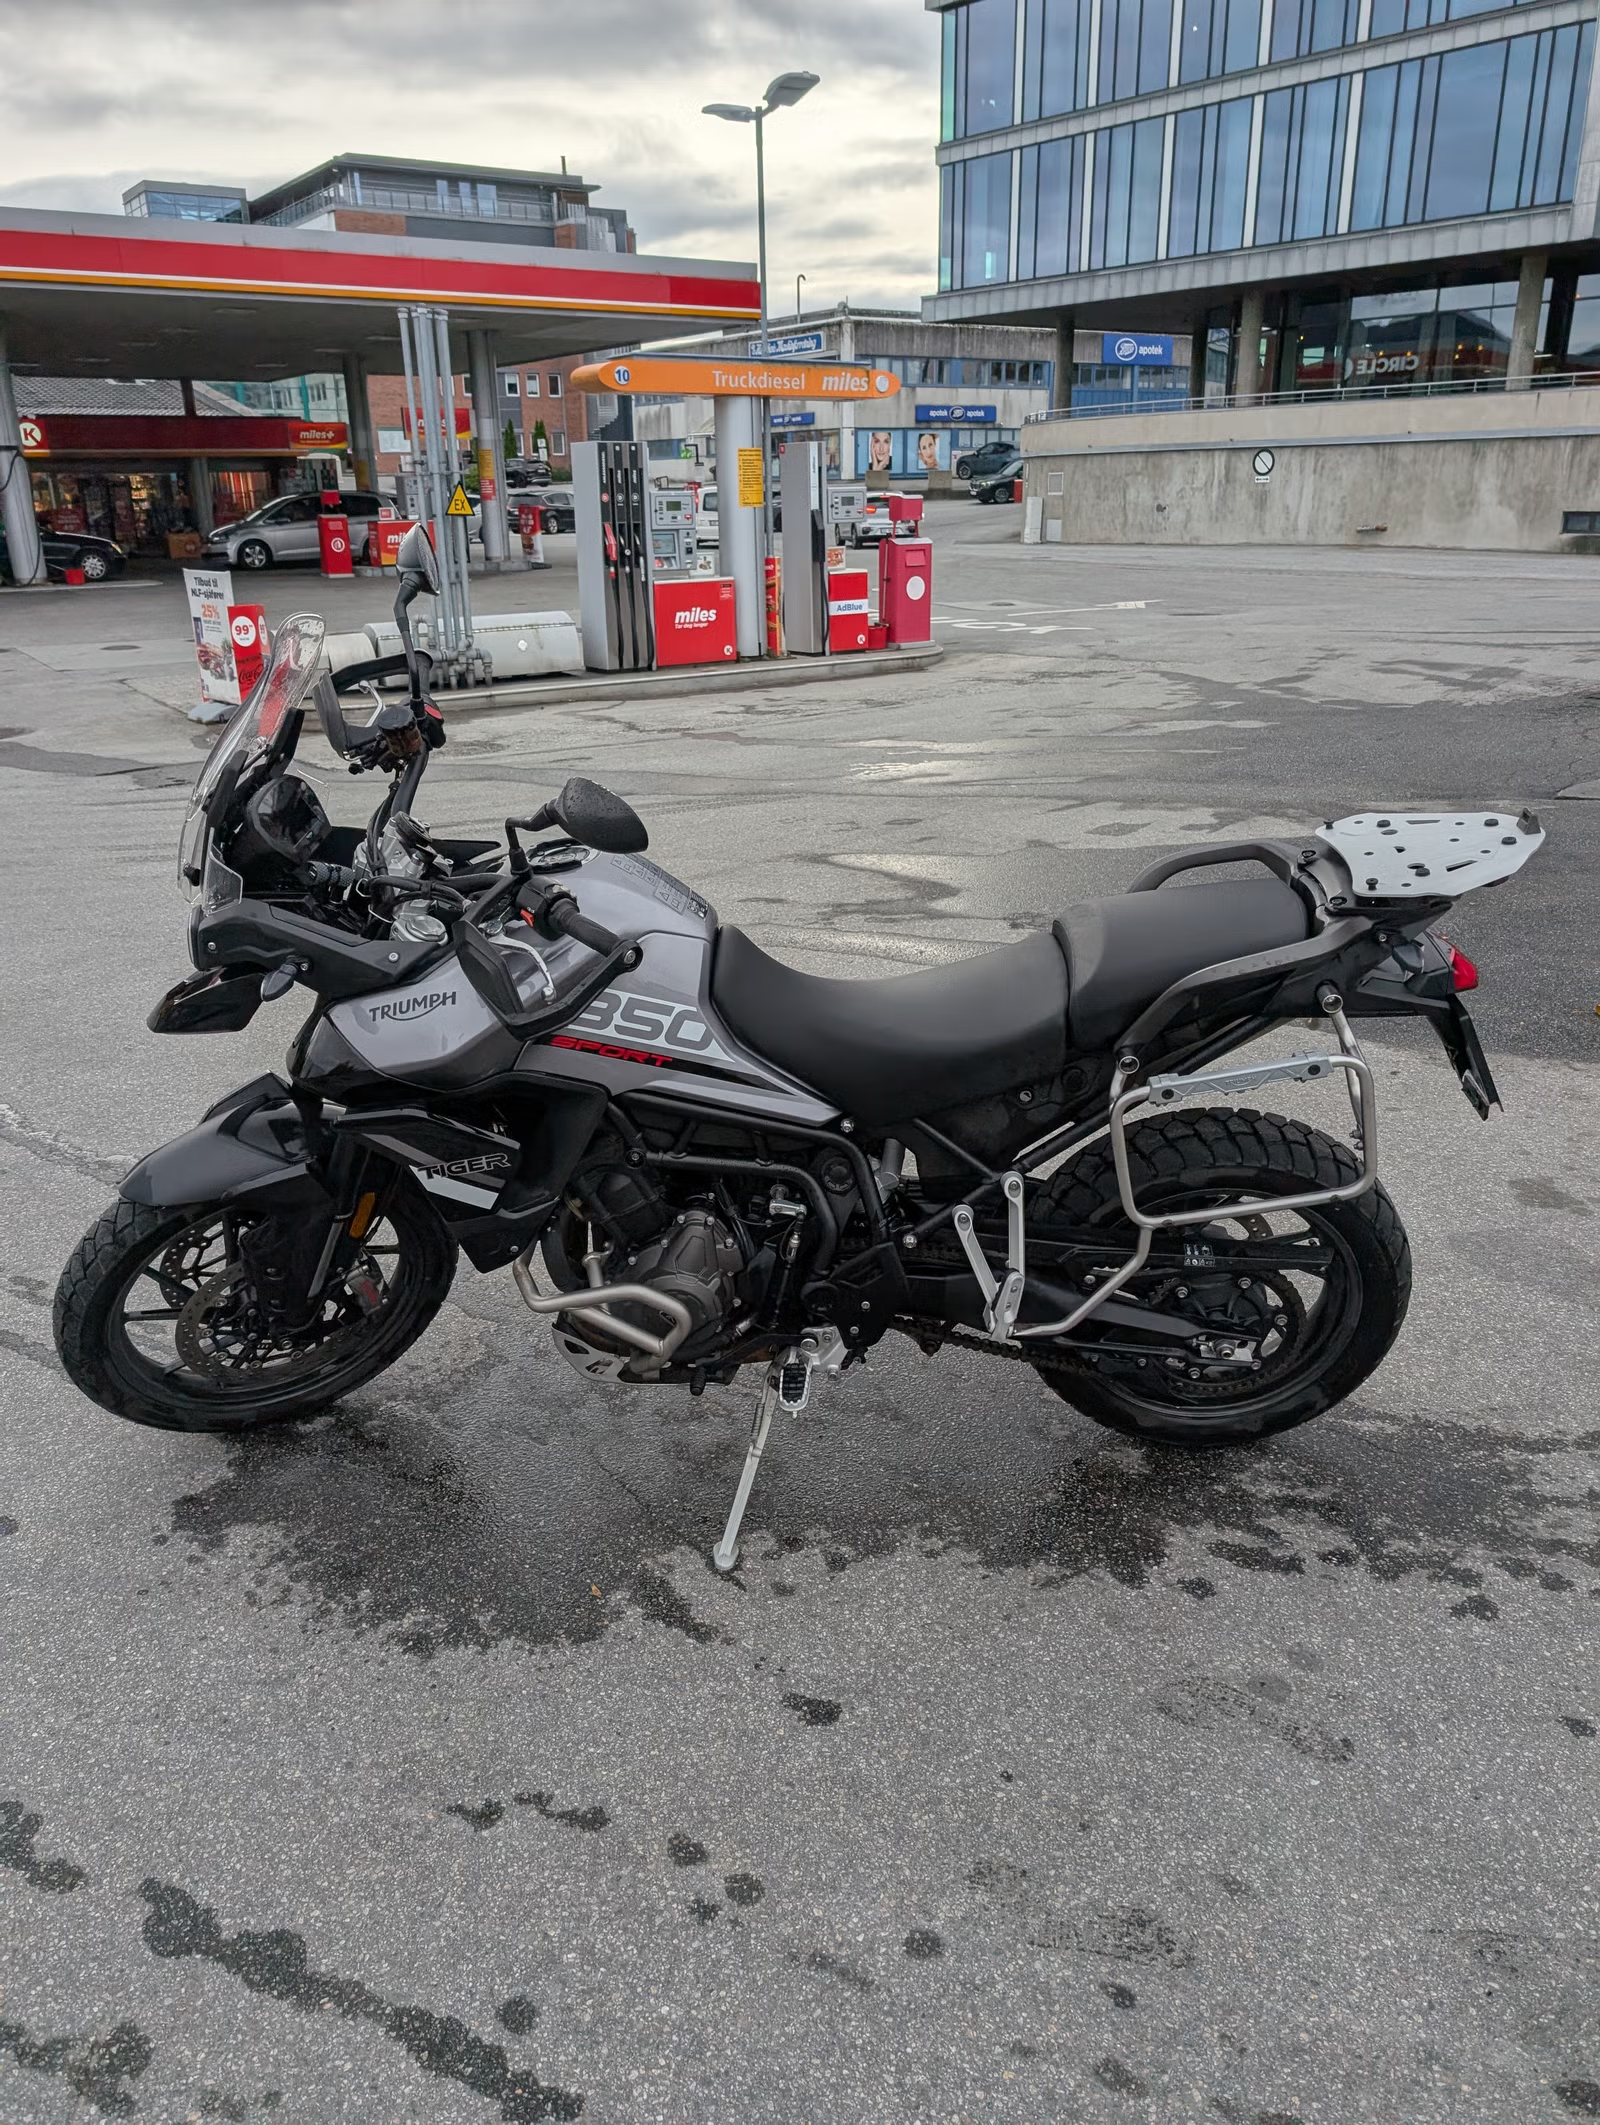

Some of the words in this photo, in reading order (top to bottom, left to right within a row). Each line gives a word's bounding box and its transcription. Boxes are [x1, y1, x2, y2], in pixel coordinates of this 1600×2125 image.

[1139, 345, 1163, 356] apotek
[616, 369, 629, 382] 10
[712, 370, 805, 390] Truckdiesel
[822, 372, 869, 391] miles
[929, 409, 948, 418] apotek
[966, 409, 985, 418] apotek
[454, 499, 466, 511] EX
[194, 577, 211, 587] Tilbud
[201, 604, 220, 619] 25%
[837, 603, 863, 612] AdBlue
[674, 607, 717, 624] miles
[369, 991, 456, 1021] TRIUMPH
[551, 1035, 673, 1067] SPORT
[417, 1152, 512, 1180] TIGER
